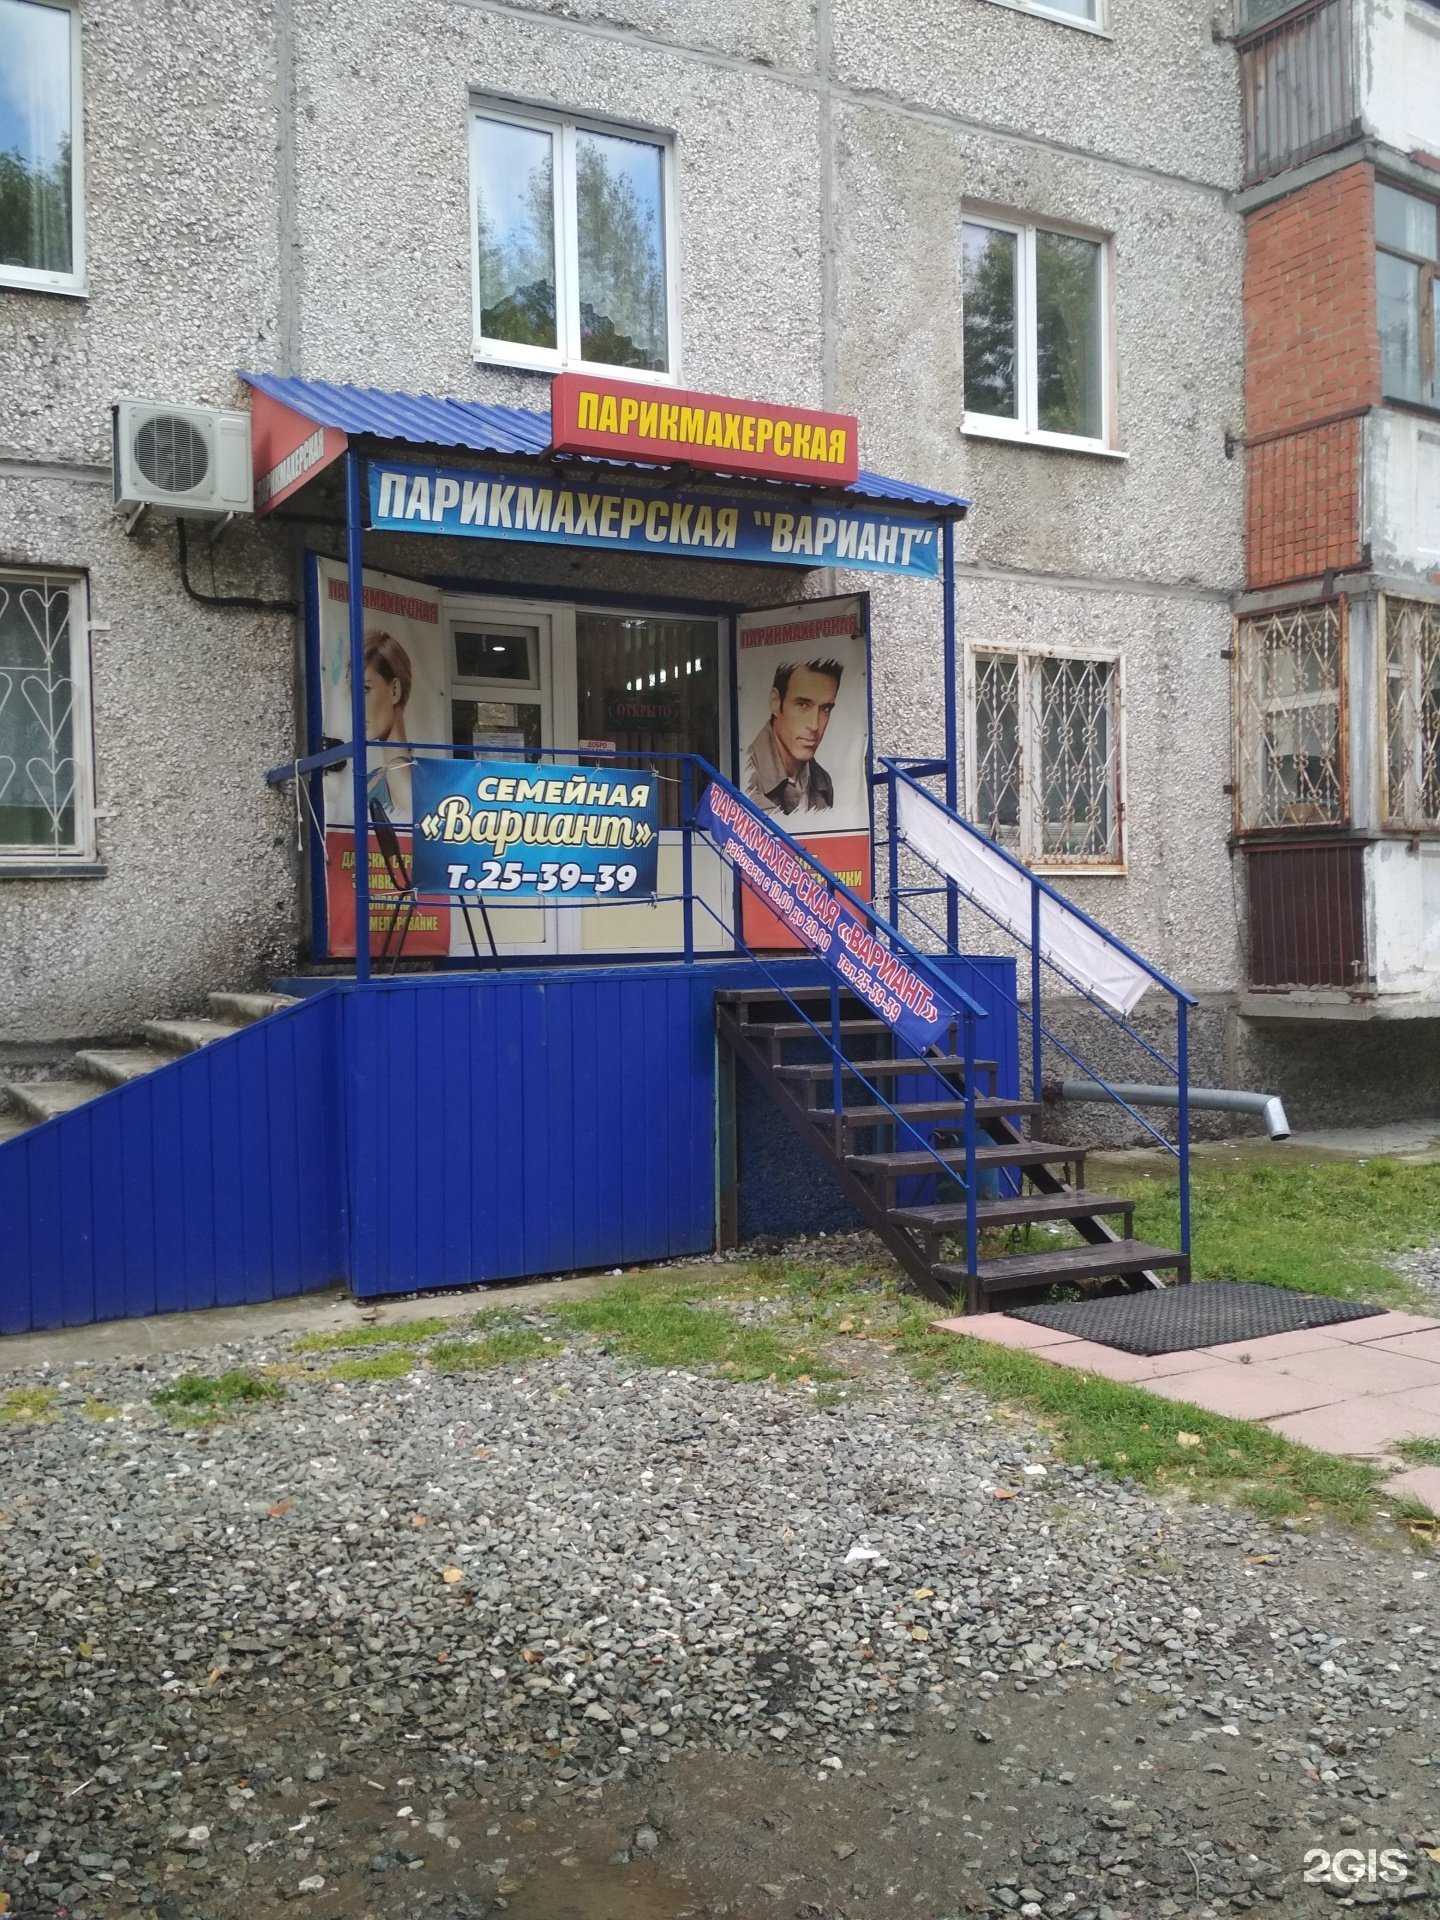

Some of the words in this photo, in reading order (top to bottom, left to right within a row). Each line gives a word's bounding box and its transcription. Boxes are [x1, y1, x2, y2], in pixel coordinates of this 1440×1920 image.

[577, 391, 847, 464] ПАРИКМАХЕРСКАЯ
[377, 472, 739, 549] ПАРИКМАХЕРСКАЯ
[477, 774, 650, 808] СЕМЕЙНАЯ
[420, 795, 657, 858] «Вариант»
[710, 782, 840, 931] ПАРИКМАХЕРСКАЯ
[838, 922, 938, 1023] «ВАРИАНТ»
[802, 915, 832, 952] 20.00
